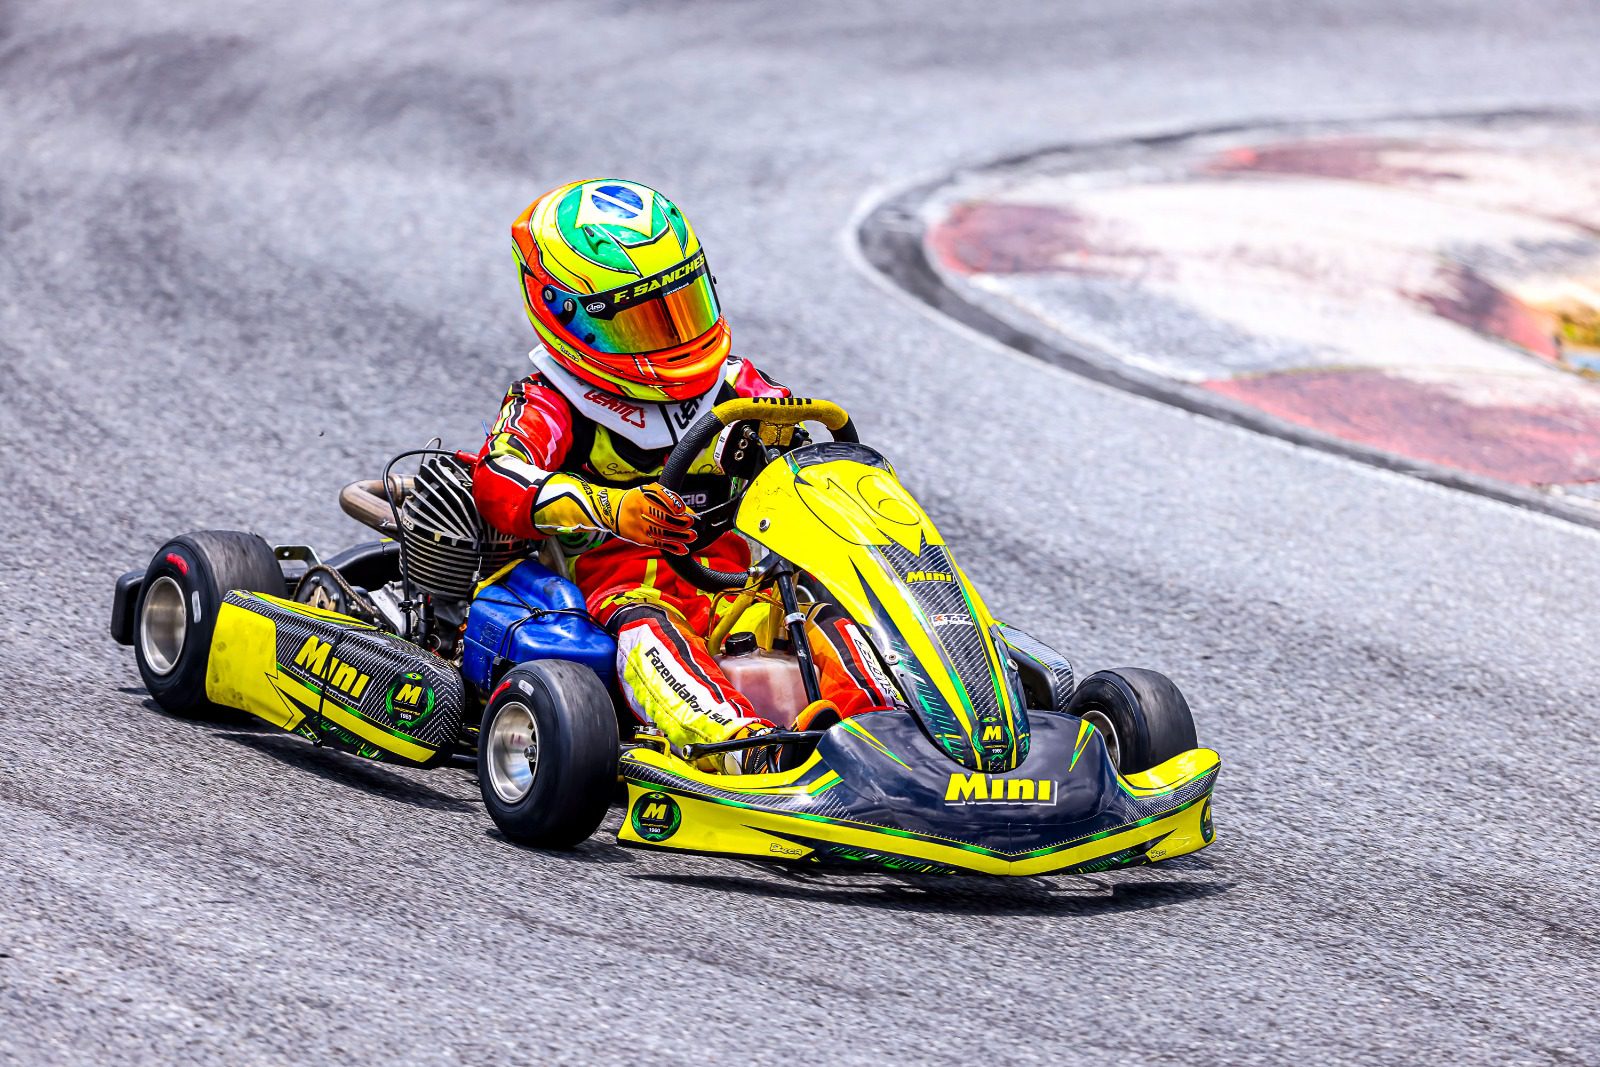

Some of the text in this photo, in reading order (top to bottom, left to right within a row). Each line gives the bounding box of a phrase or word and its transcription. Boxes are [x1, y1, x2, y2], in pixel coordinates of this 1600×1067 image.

[613, 289, 631, 304] F.
[633, 253, 705, 298] SANCHES
[906, 570, 953, 584] Mini
[293, 634, 371, 699] Mini
[394, 683, 423, 705] M
[982, 725, 1003, 741] M
[944, 772, 1051, 801] Mini
[641, 802, 668, 820] M
